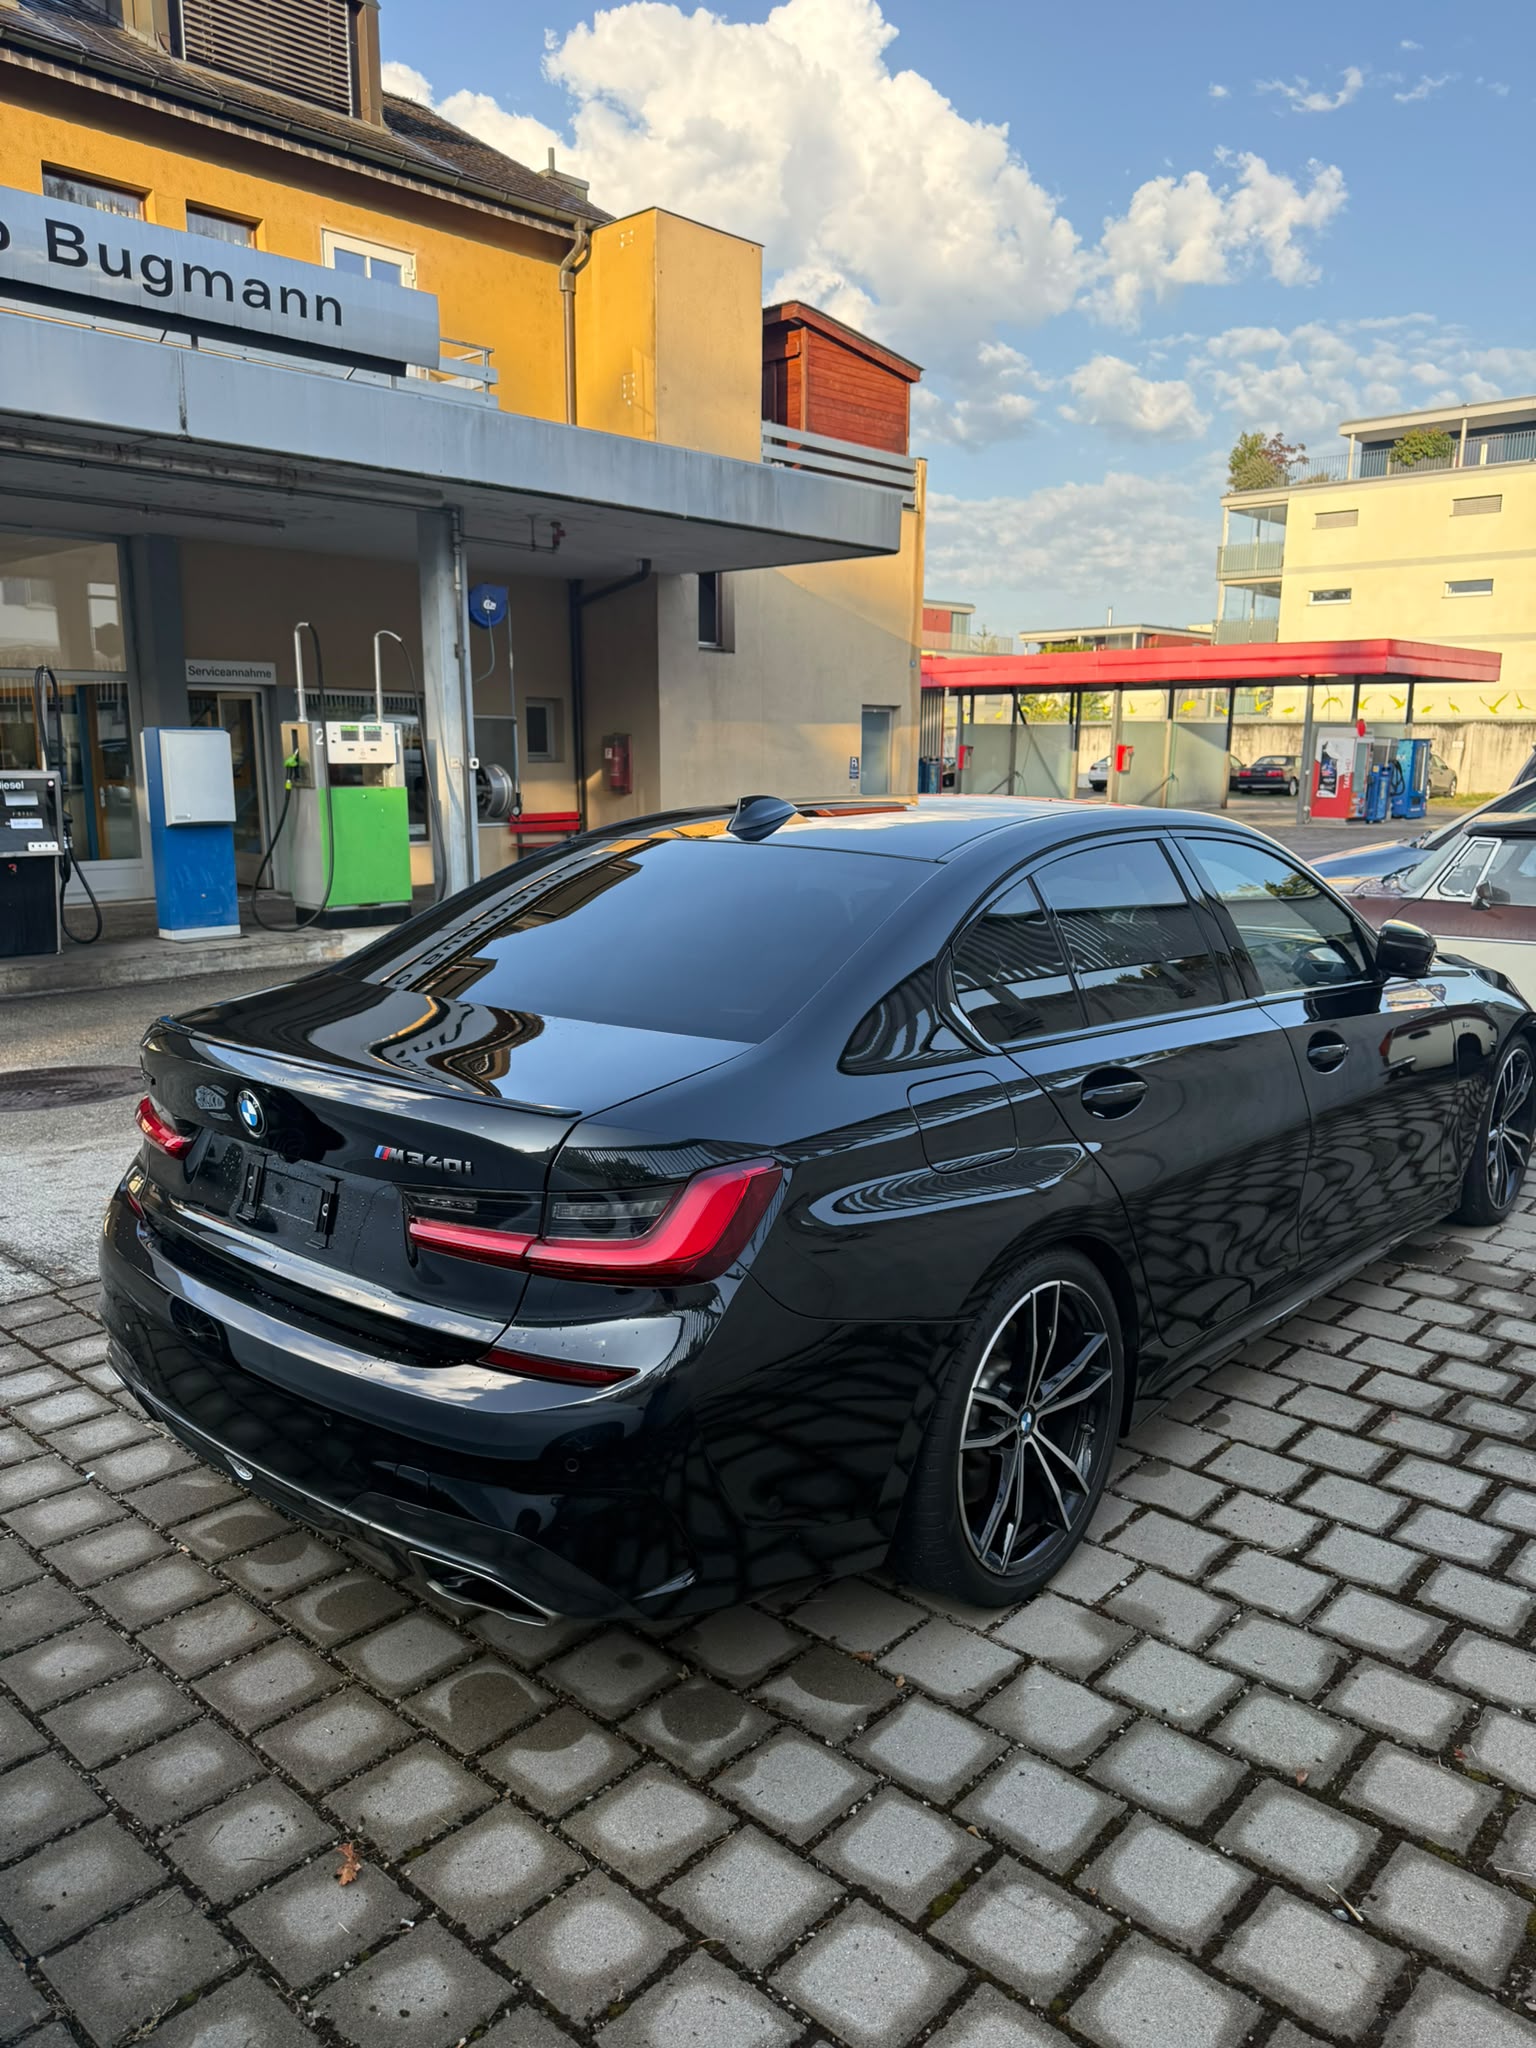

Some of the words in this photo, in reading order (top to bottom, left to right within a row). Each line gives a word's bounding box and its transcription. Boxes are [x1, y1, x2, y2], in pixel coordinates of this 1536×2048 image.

[45, 218, 343, 327] Bugmann
[188, 665, 272, 678] Serviceannahme
[315, 728, 324, 745] 2
[388, 1148, 472, 1176] M340i
